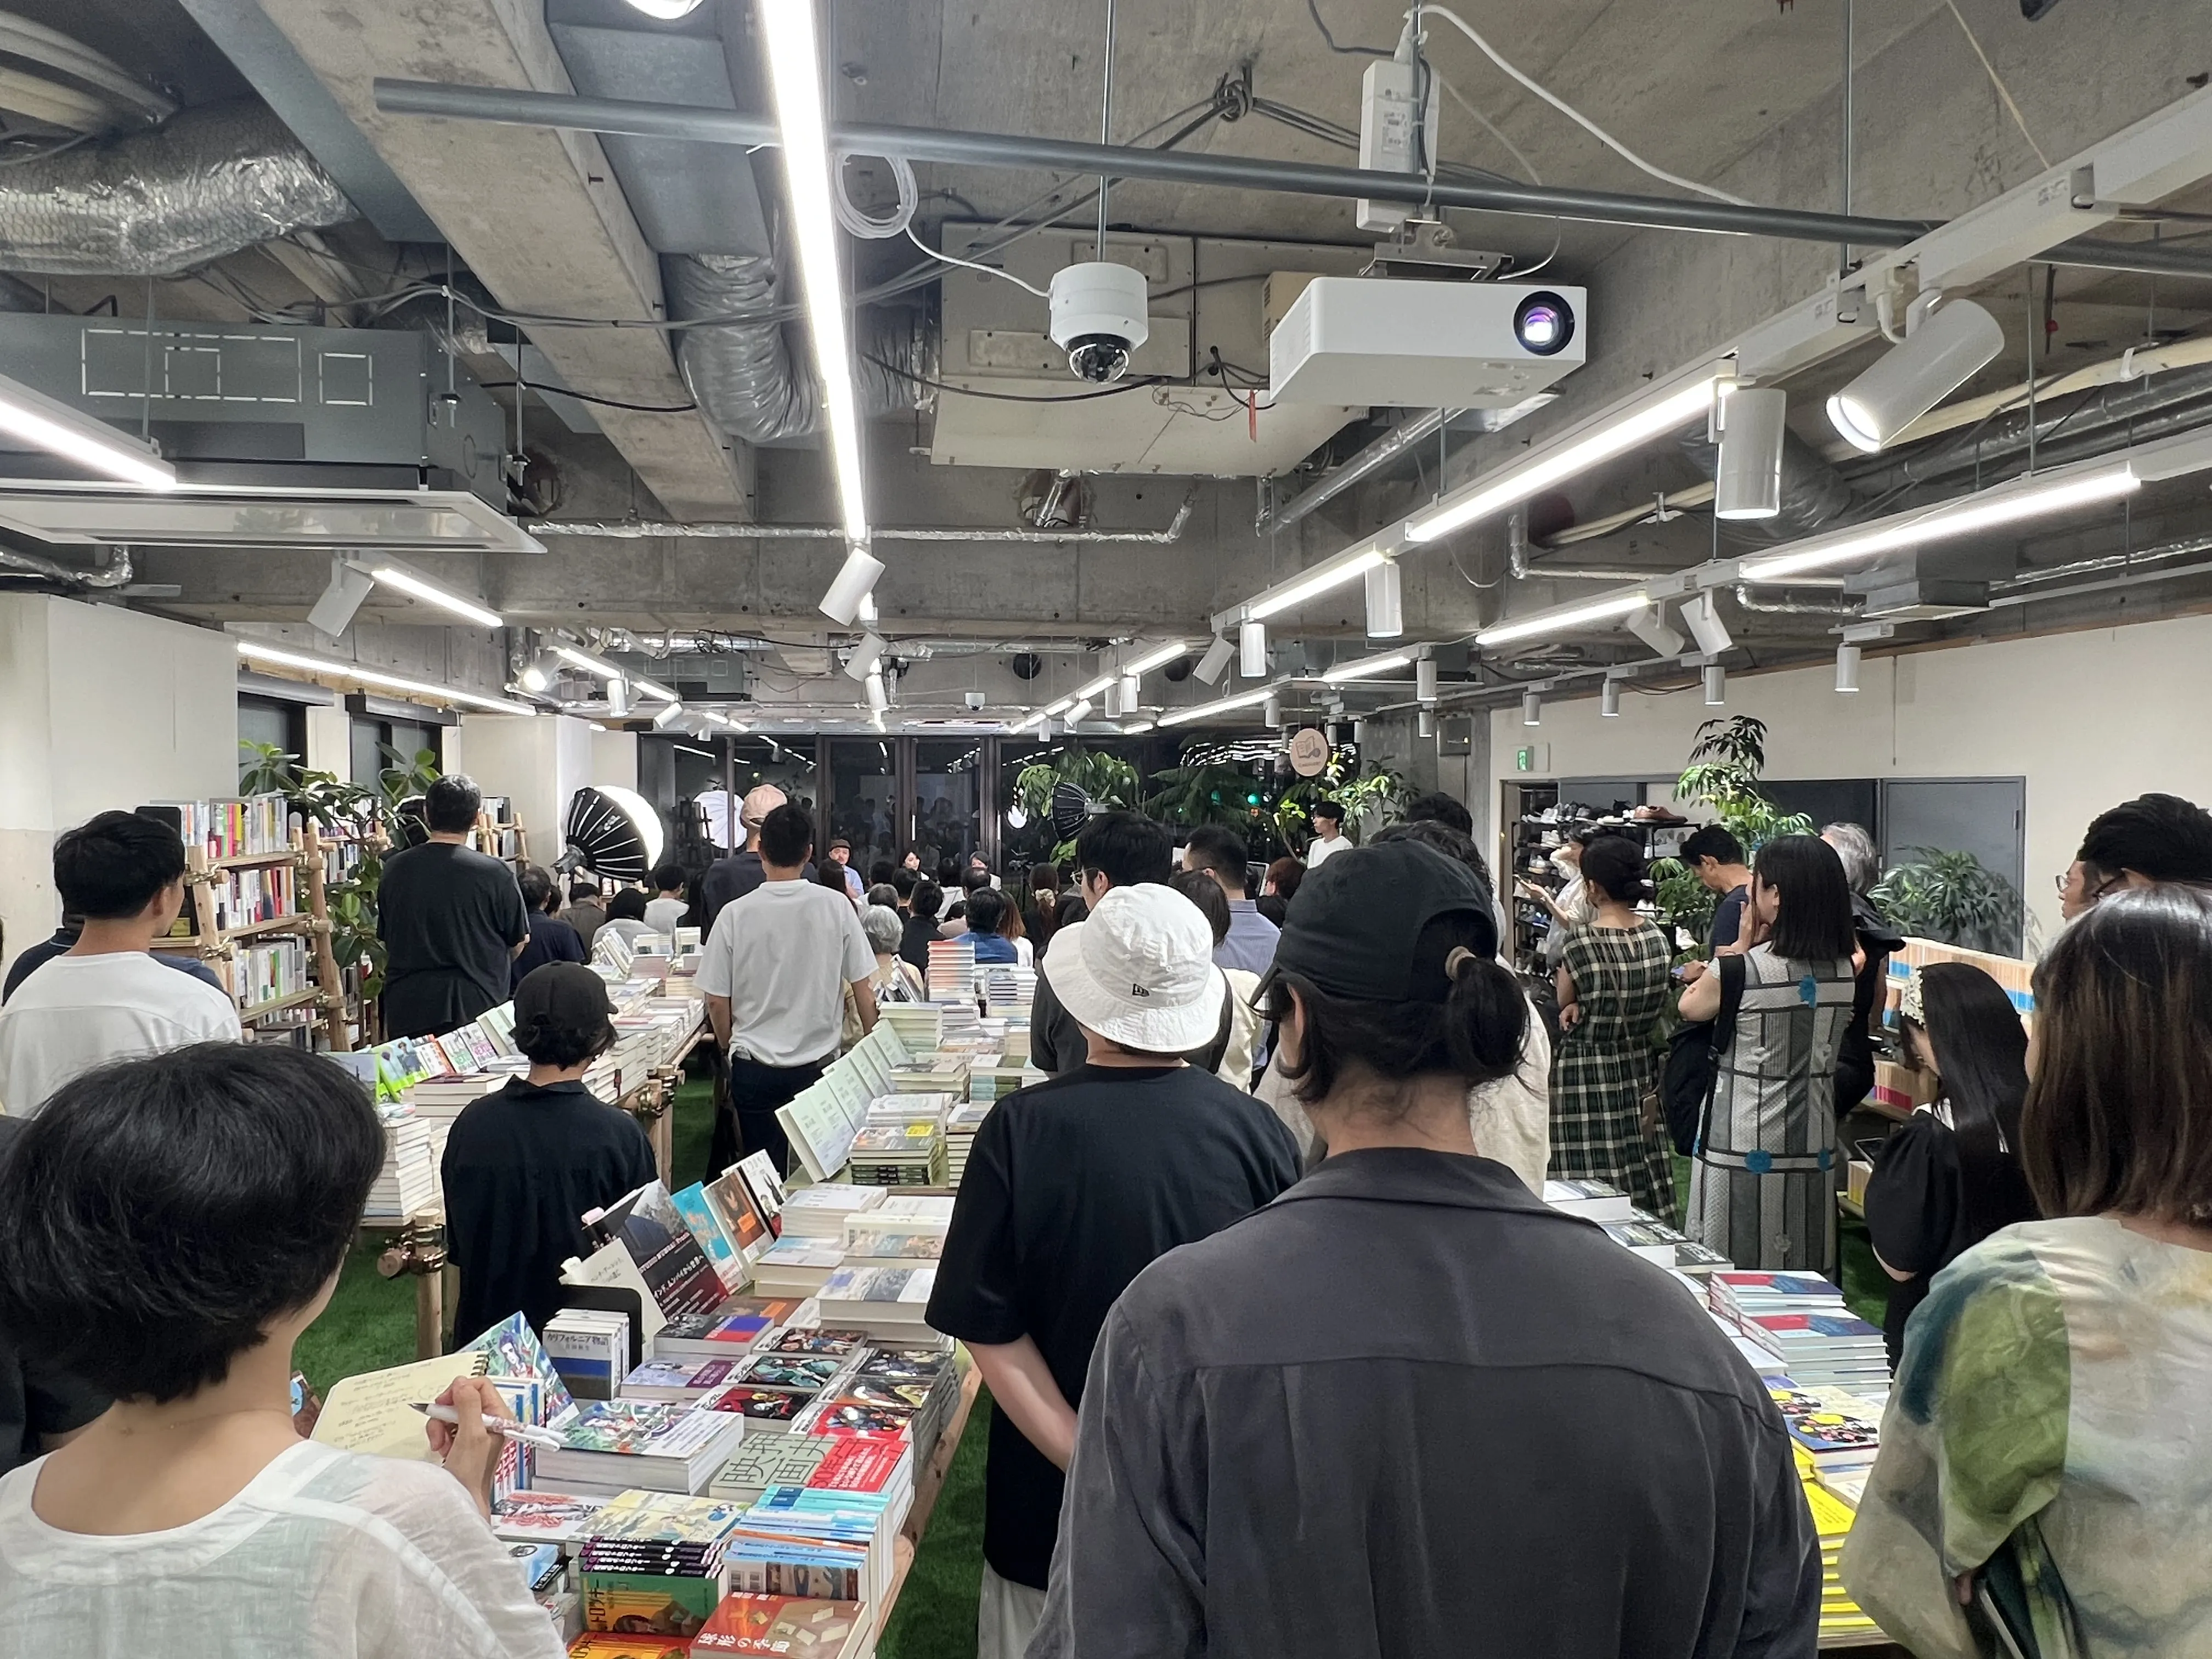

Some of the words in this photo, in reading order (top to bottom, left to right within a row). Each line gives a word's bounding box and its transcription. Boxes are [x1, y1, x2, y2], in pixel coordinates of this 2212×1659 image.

[548, 1333, 609, 1346] カリフォルニア物語
